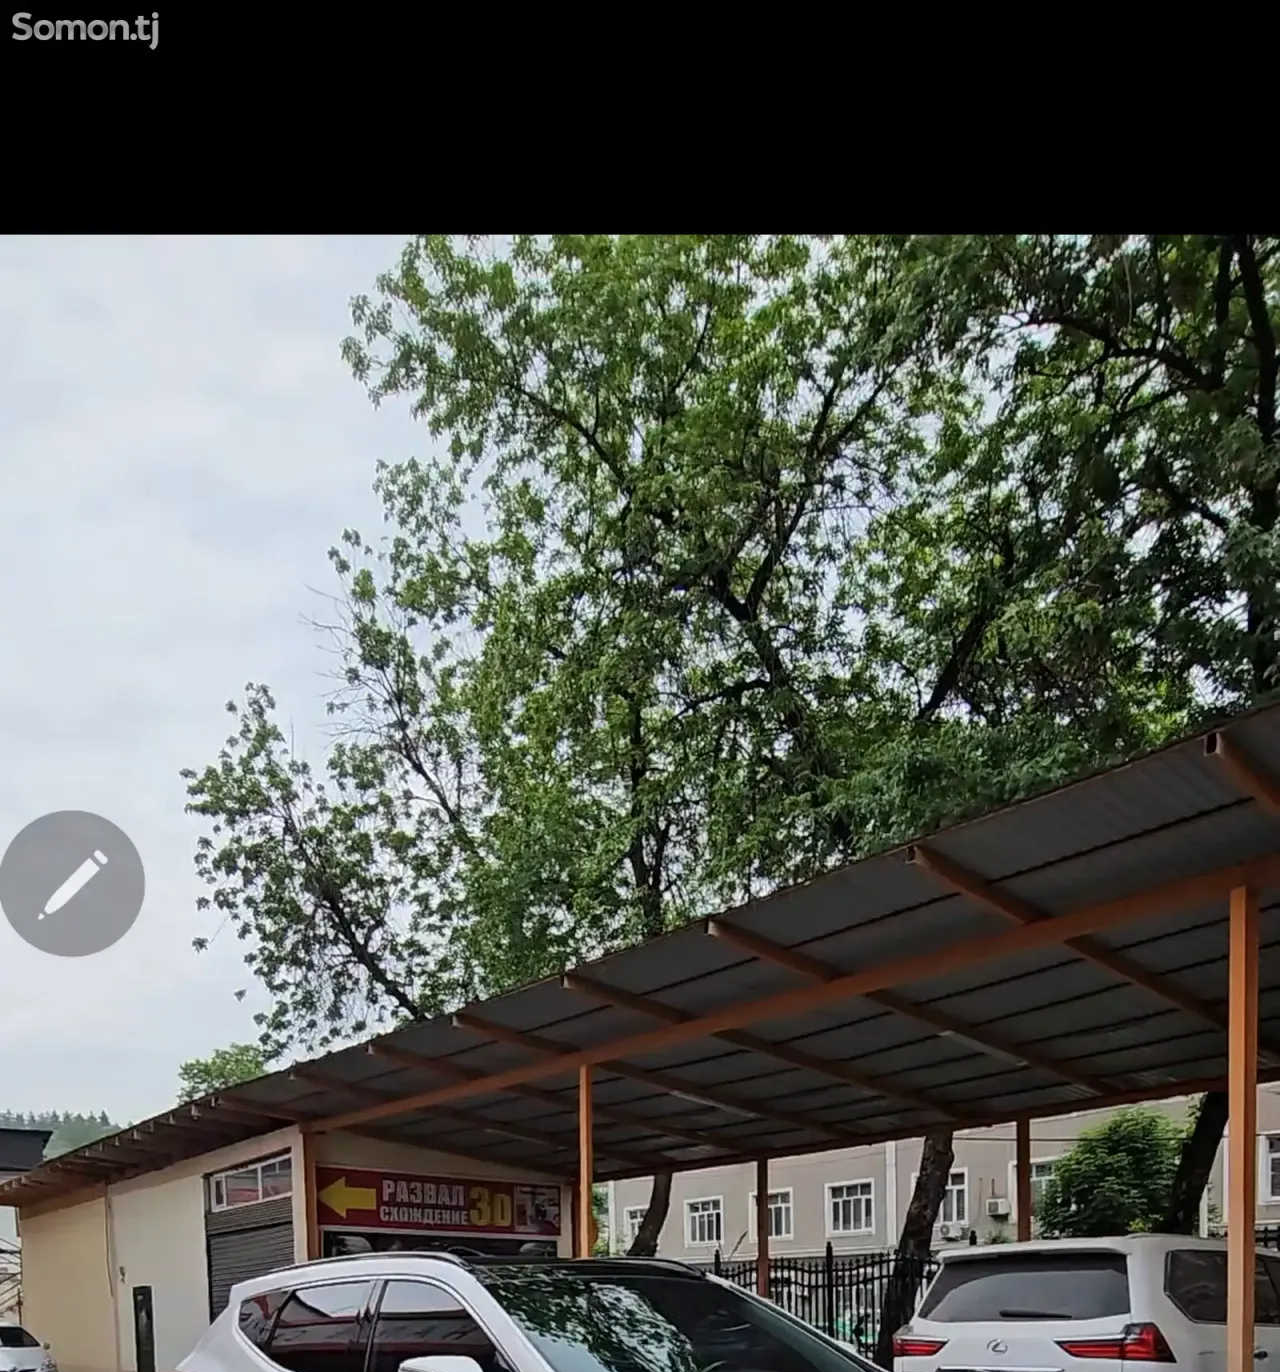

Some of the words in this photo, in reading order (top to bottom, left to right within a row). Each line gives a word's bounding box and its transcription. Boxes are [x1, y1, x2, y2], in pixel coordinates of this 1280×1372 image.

[382, 1179, 465, 1206] РАЗВАЛ
[380, 1205, 469, 1226] СХОЖДЕНИЕ
[469, 1186, 512, 1227] 3D
